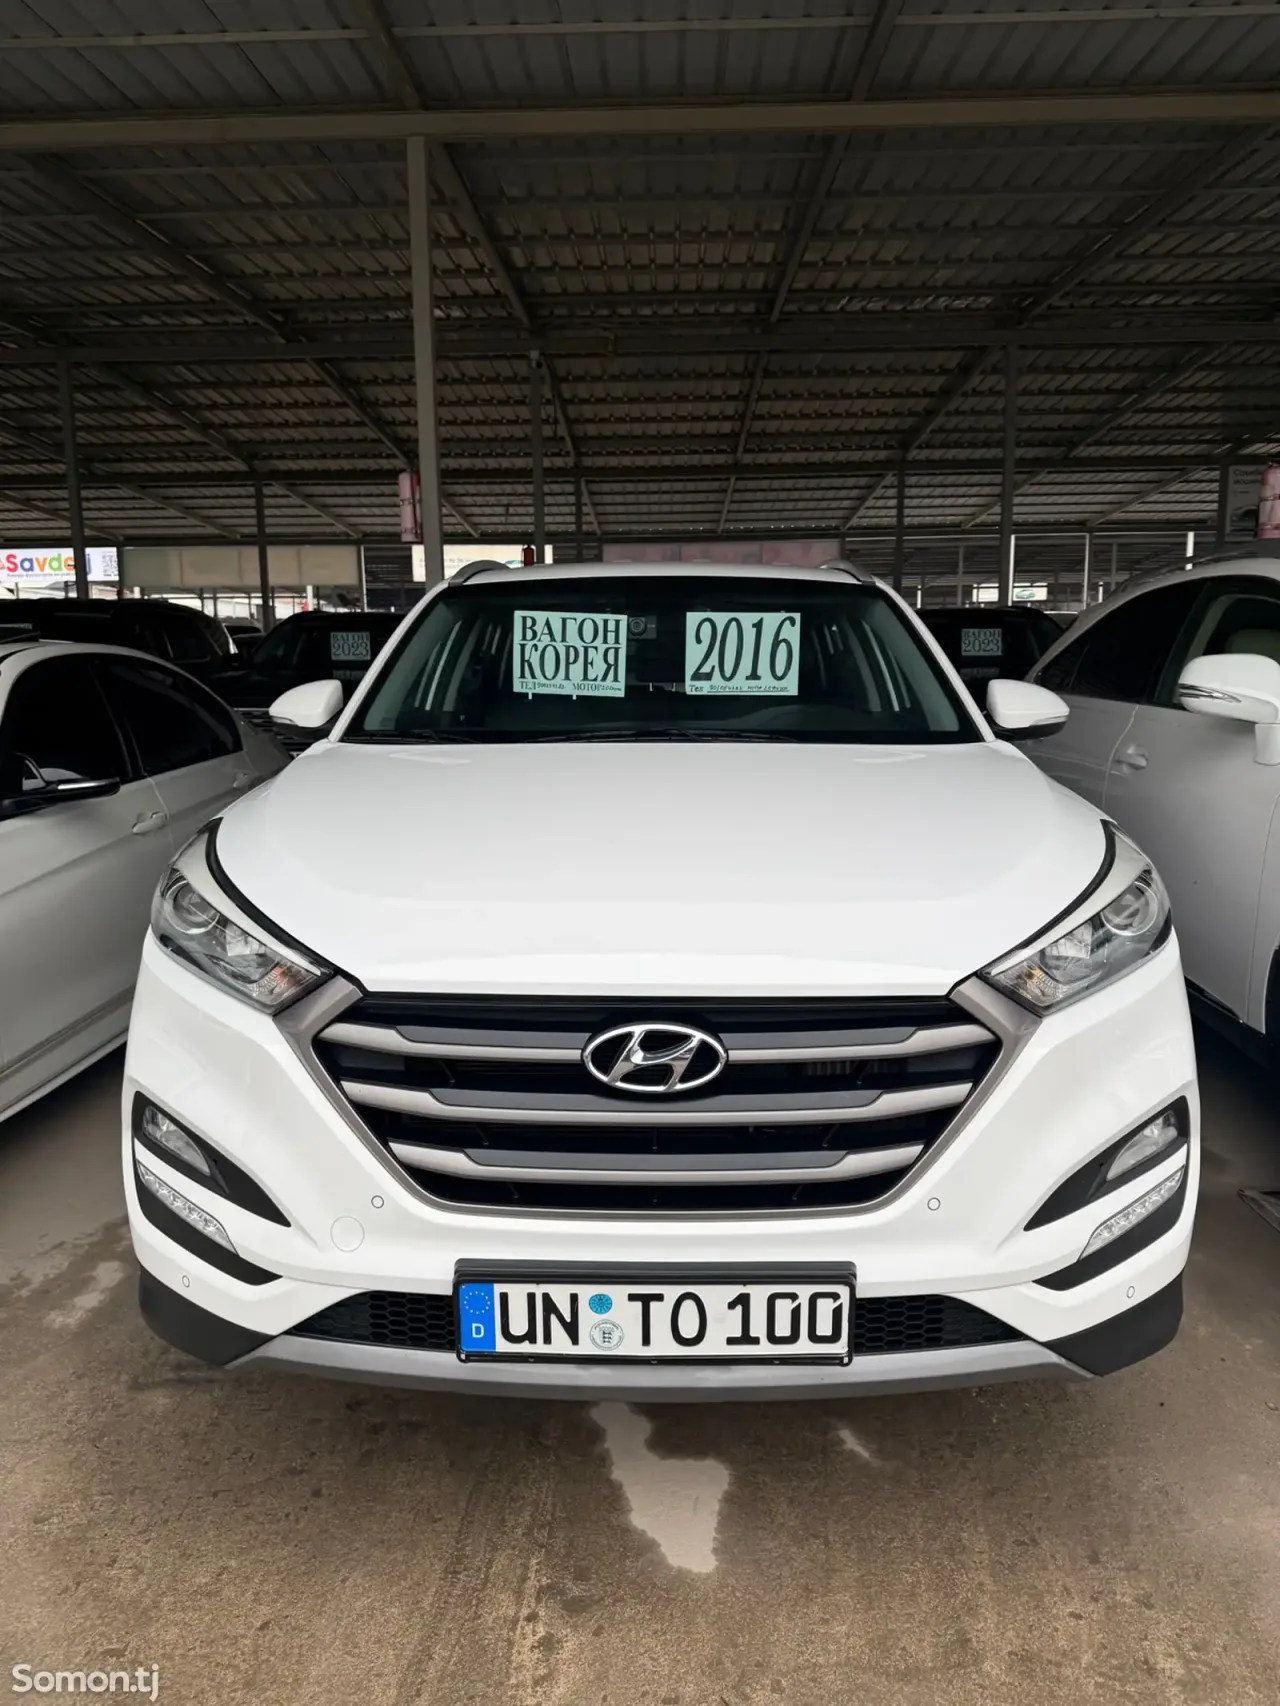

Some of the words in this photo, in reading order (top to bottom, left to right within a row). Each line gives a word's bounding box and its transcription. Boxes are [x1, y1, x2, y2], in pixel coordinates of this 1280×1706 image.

[520, 615, 623, 644] ВАГОН
[332, 641, 369, 657] 2023
[689, 615, 797, 682] 2016
[962, 638, 1000, 653] 2023
[518, 643, 622, 683] КОРЕЯ
[471, 1323, 485, 1339] D
[499, 1291, 579, 1346] UN
[628, 1291, 708, 1347] TO
[726, 1291, 844, 1346] 100
